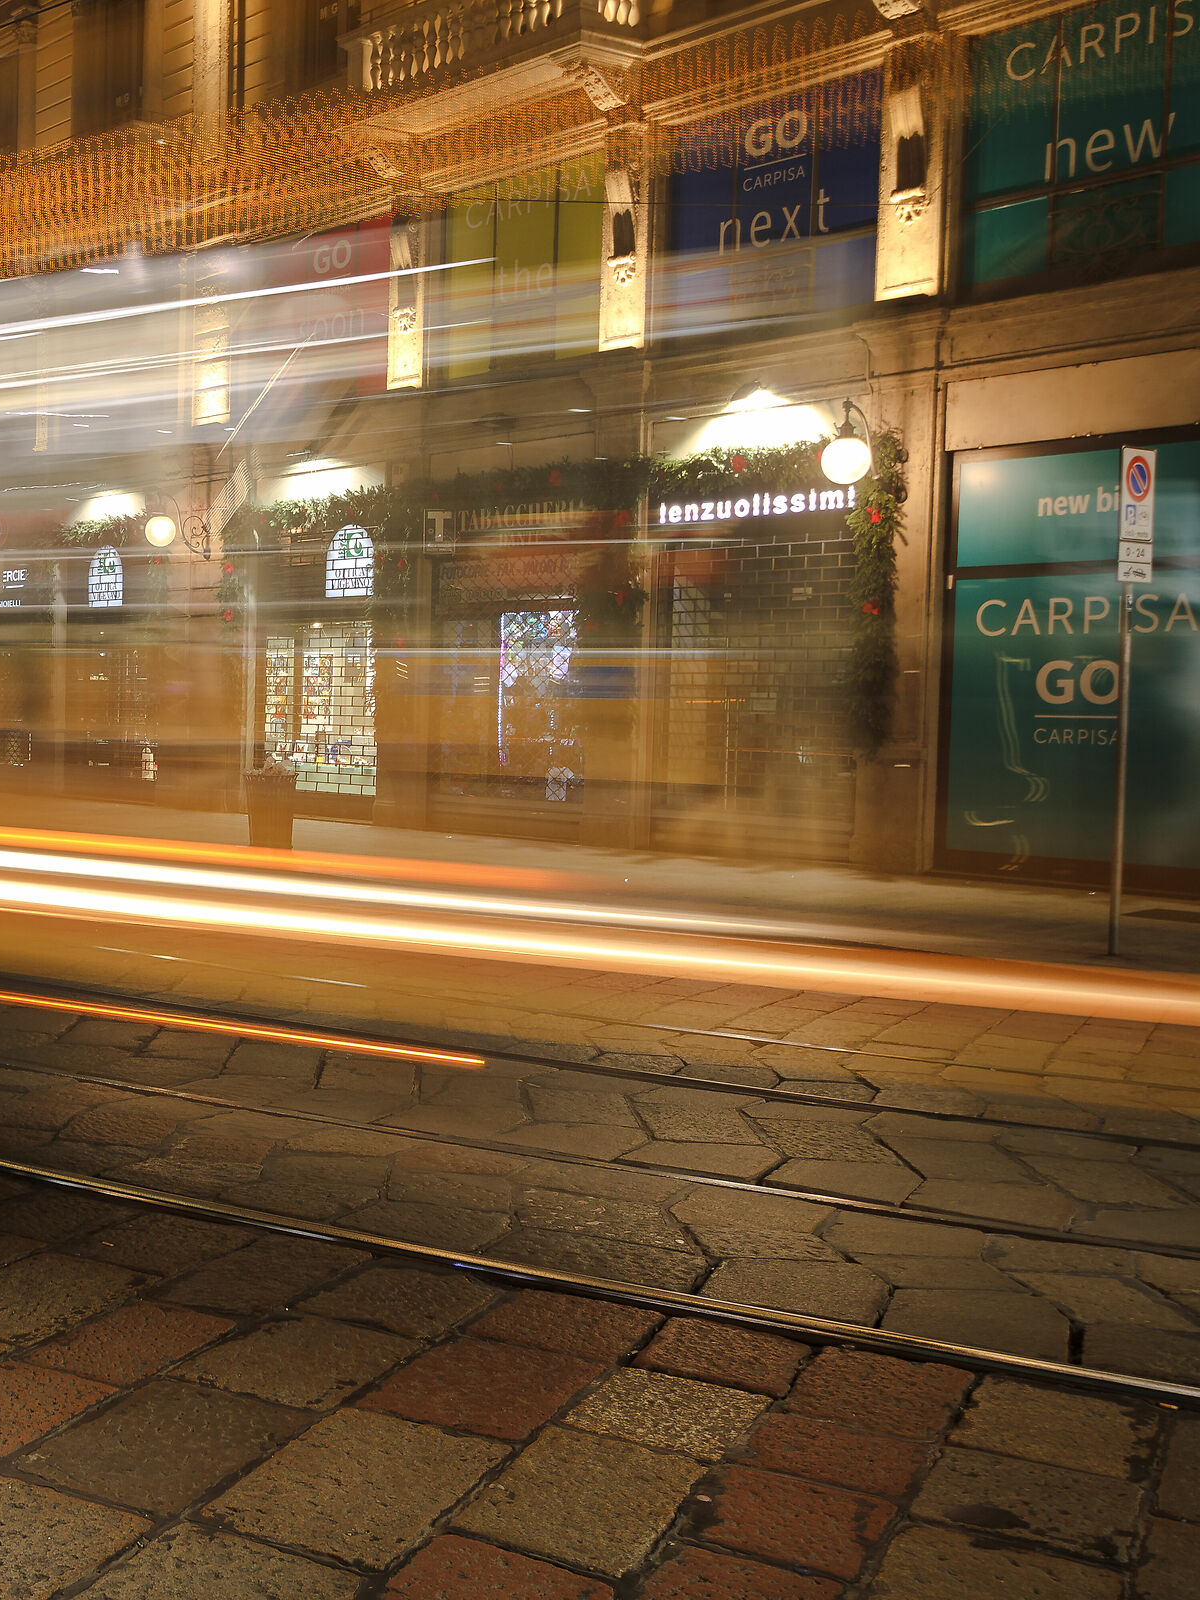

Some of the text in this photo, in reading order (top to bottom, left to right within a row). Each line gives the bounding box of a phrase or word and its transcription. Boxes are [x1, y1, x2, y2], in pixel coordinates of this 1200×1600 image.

[1006, 0, 1200, 81] CARPIS
[745, 110, 807, 157] GO
[1044, 112, 1176, 182] new
[466, 170, 592, 229] CARPISA
[743, 165, 806, 192] CARPISA
[719, 188, 830, 256] next
[313, 239, 352, 274] GO
[498, 259, 553, 302] the
[458, 499, 586, 532] TABACCHERIA
[1037, 485, 1120, 517] new bi
[427, 511, 452, 542] T
[976, 593, 1200, 636] CARPISA
[1035, 660, 1119, 705] GO
